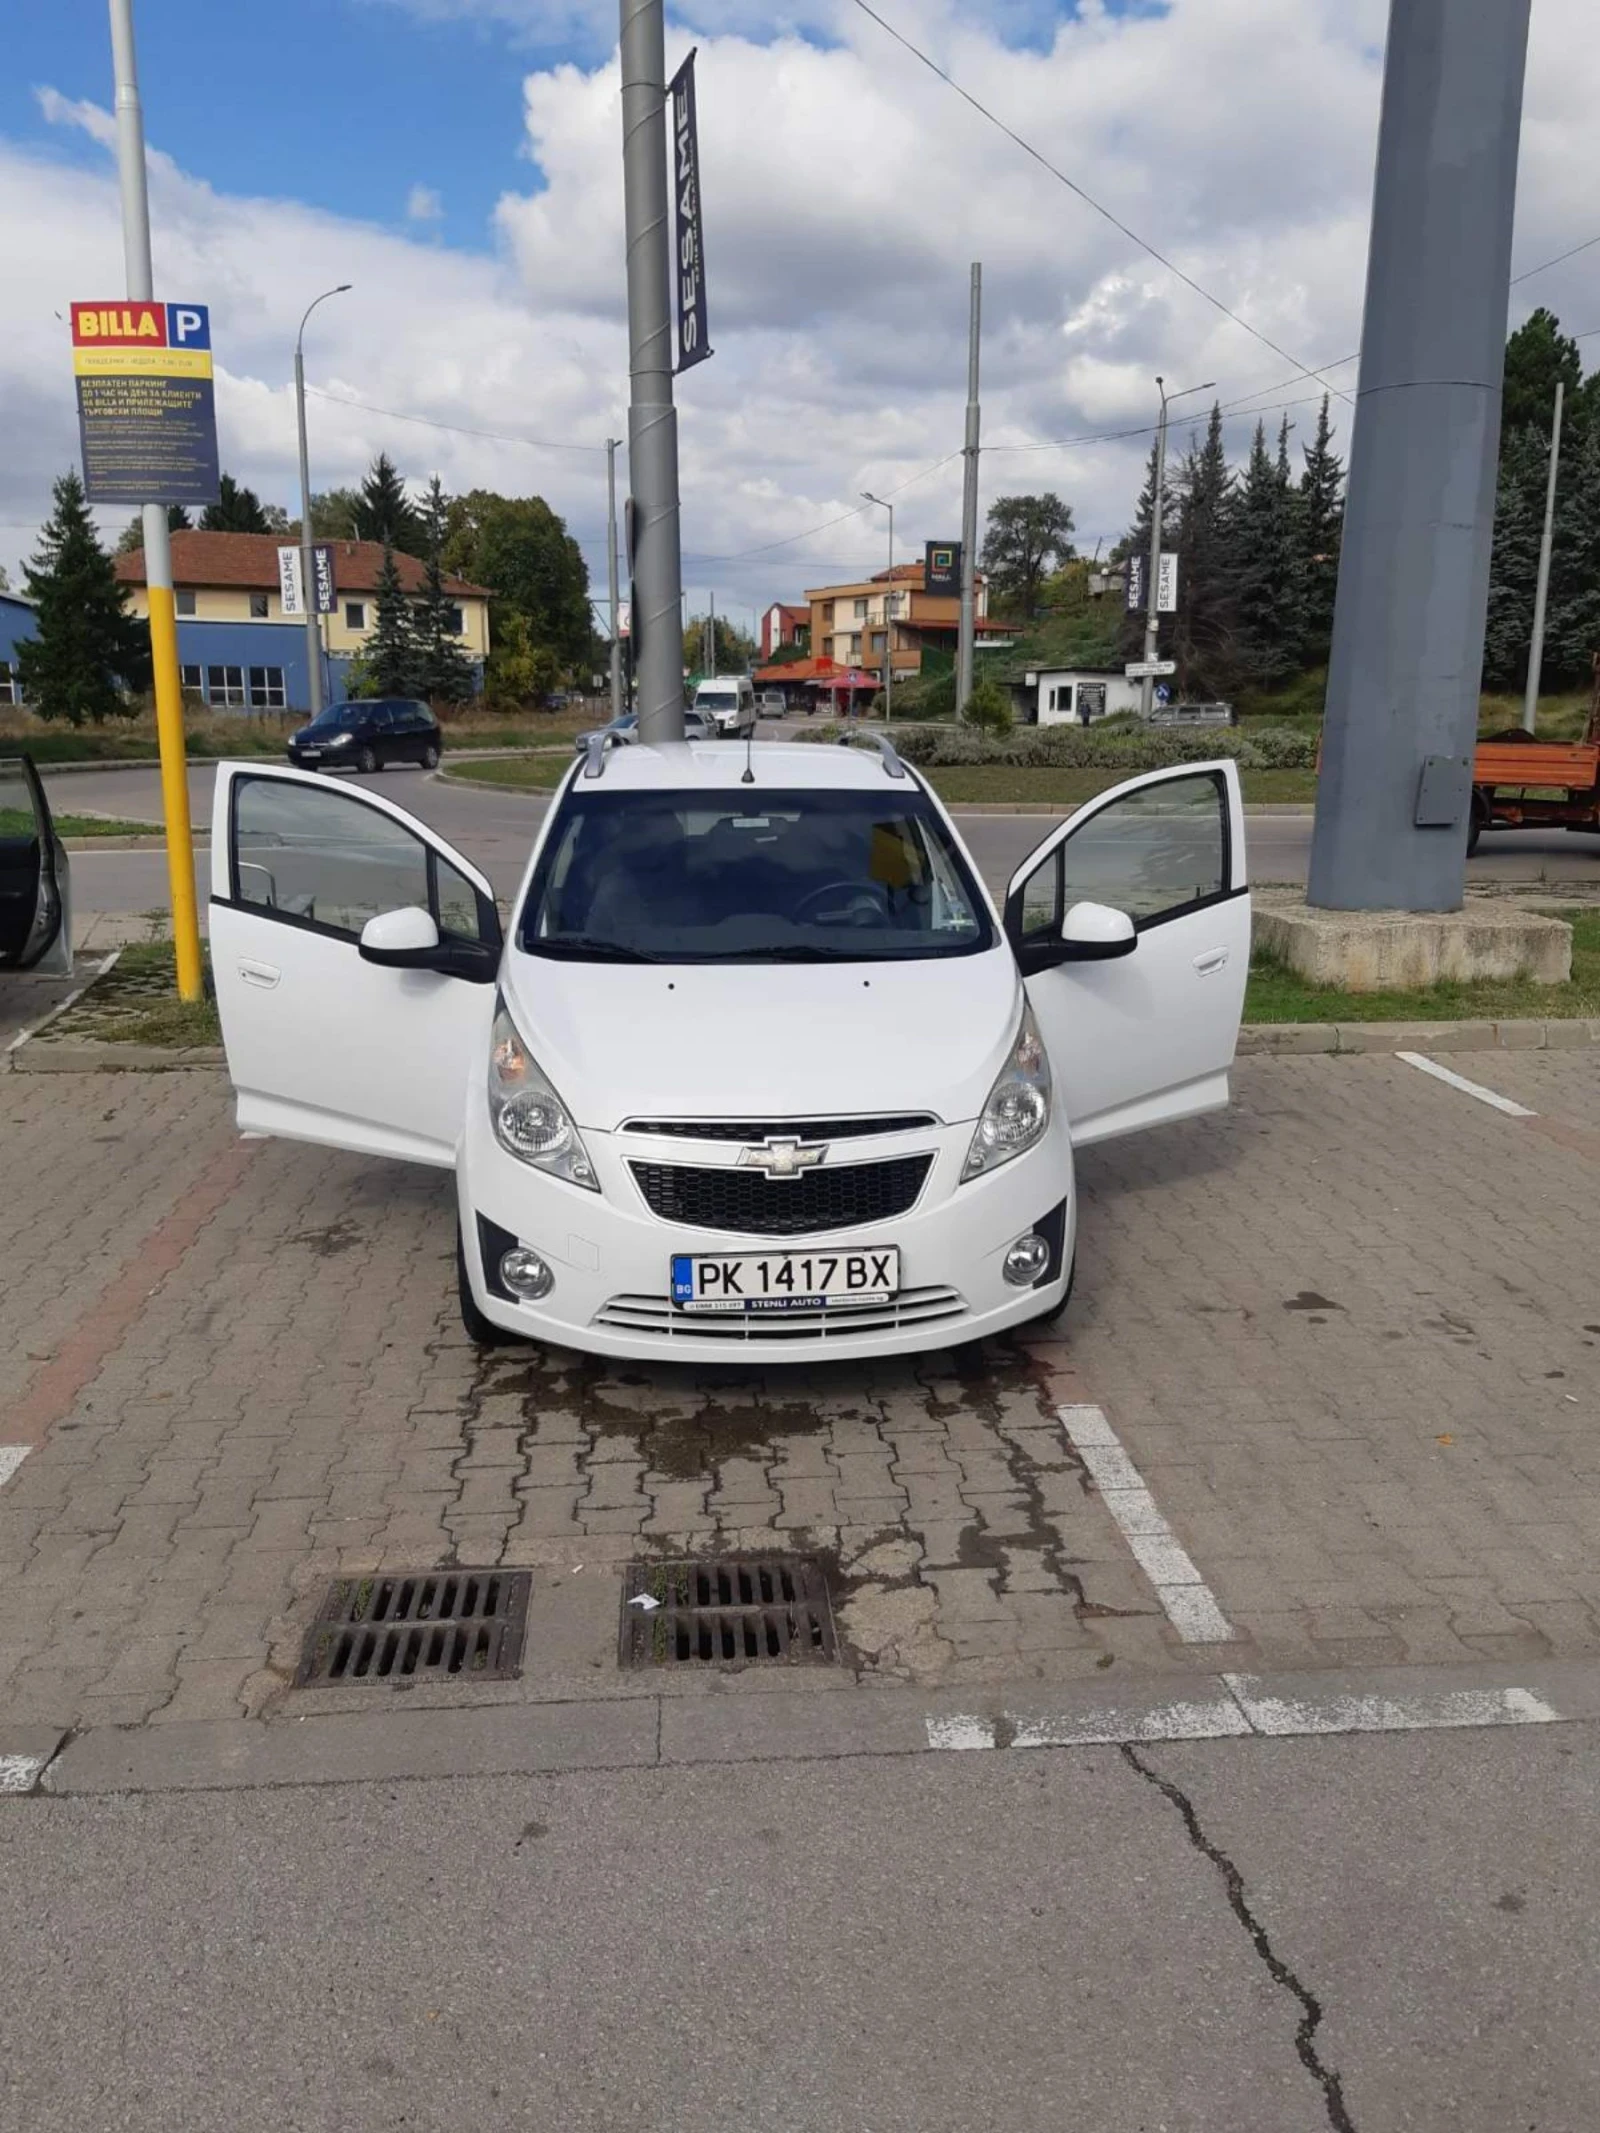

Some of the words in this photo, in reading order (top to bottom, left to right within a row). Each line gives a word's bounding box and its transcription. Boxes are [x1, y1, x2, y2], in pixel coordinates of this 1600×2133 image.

[676, 77, 697, 352] SESAME
[78, 310, 160, 337] BILLA
[176, 310, 201, 342] P
[101, 389, 117, 397] ЧАС
[117, 389, 129, 398] НА
[130, 390, 148, 399] ДЕН
[149, 390, 161, 398] ЗА
[129, 380, 167, 389] ПАРКИНГ
[282, 551, 296, 612] SESAME
[315, 548, 330, 612] SESAME
[1128, 555, 1141, 609] SESAME
[1159, 557, 1171, 609] SESAME
[676, 1285, 692, 1295] BG
[699, 1262, 744, 1295] PK
[757, 1258, 838, 1293] 1417
[846, 1255, 891, 1289] BX
[751, 1298, 788, 1309] STENLI
[790, 1297, 822, 1307] AUTO
